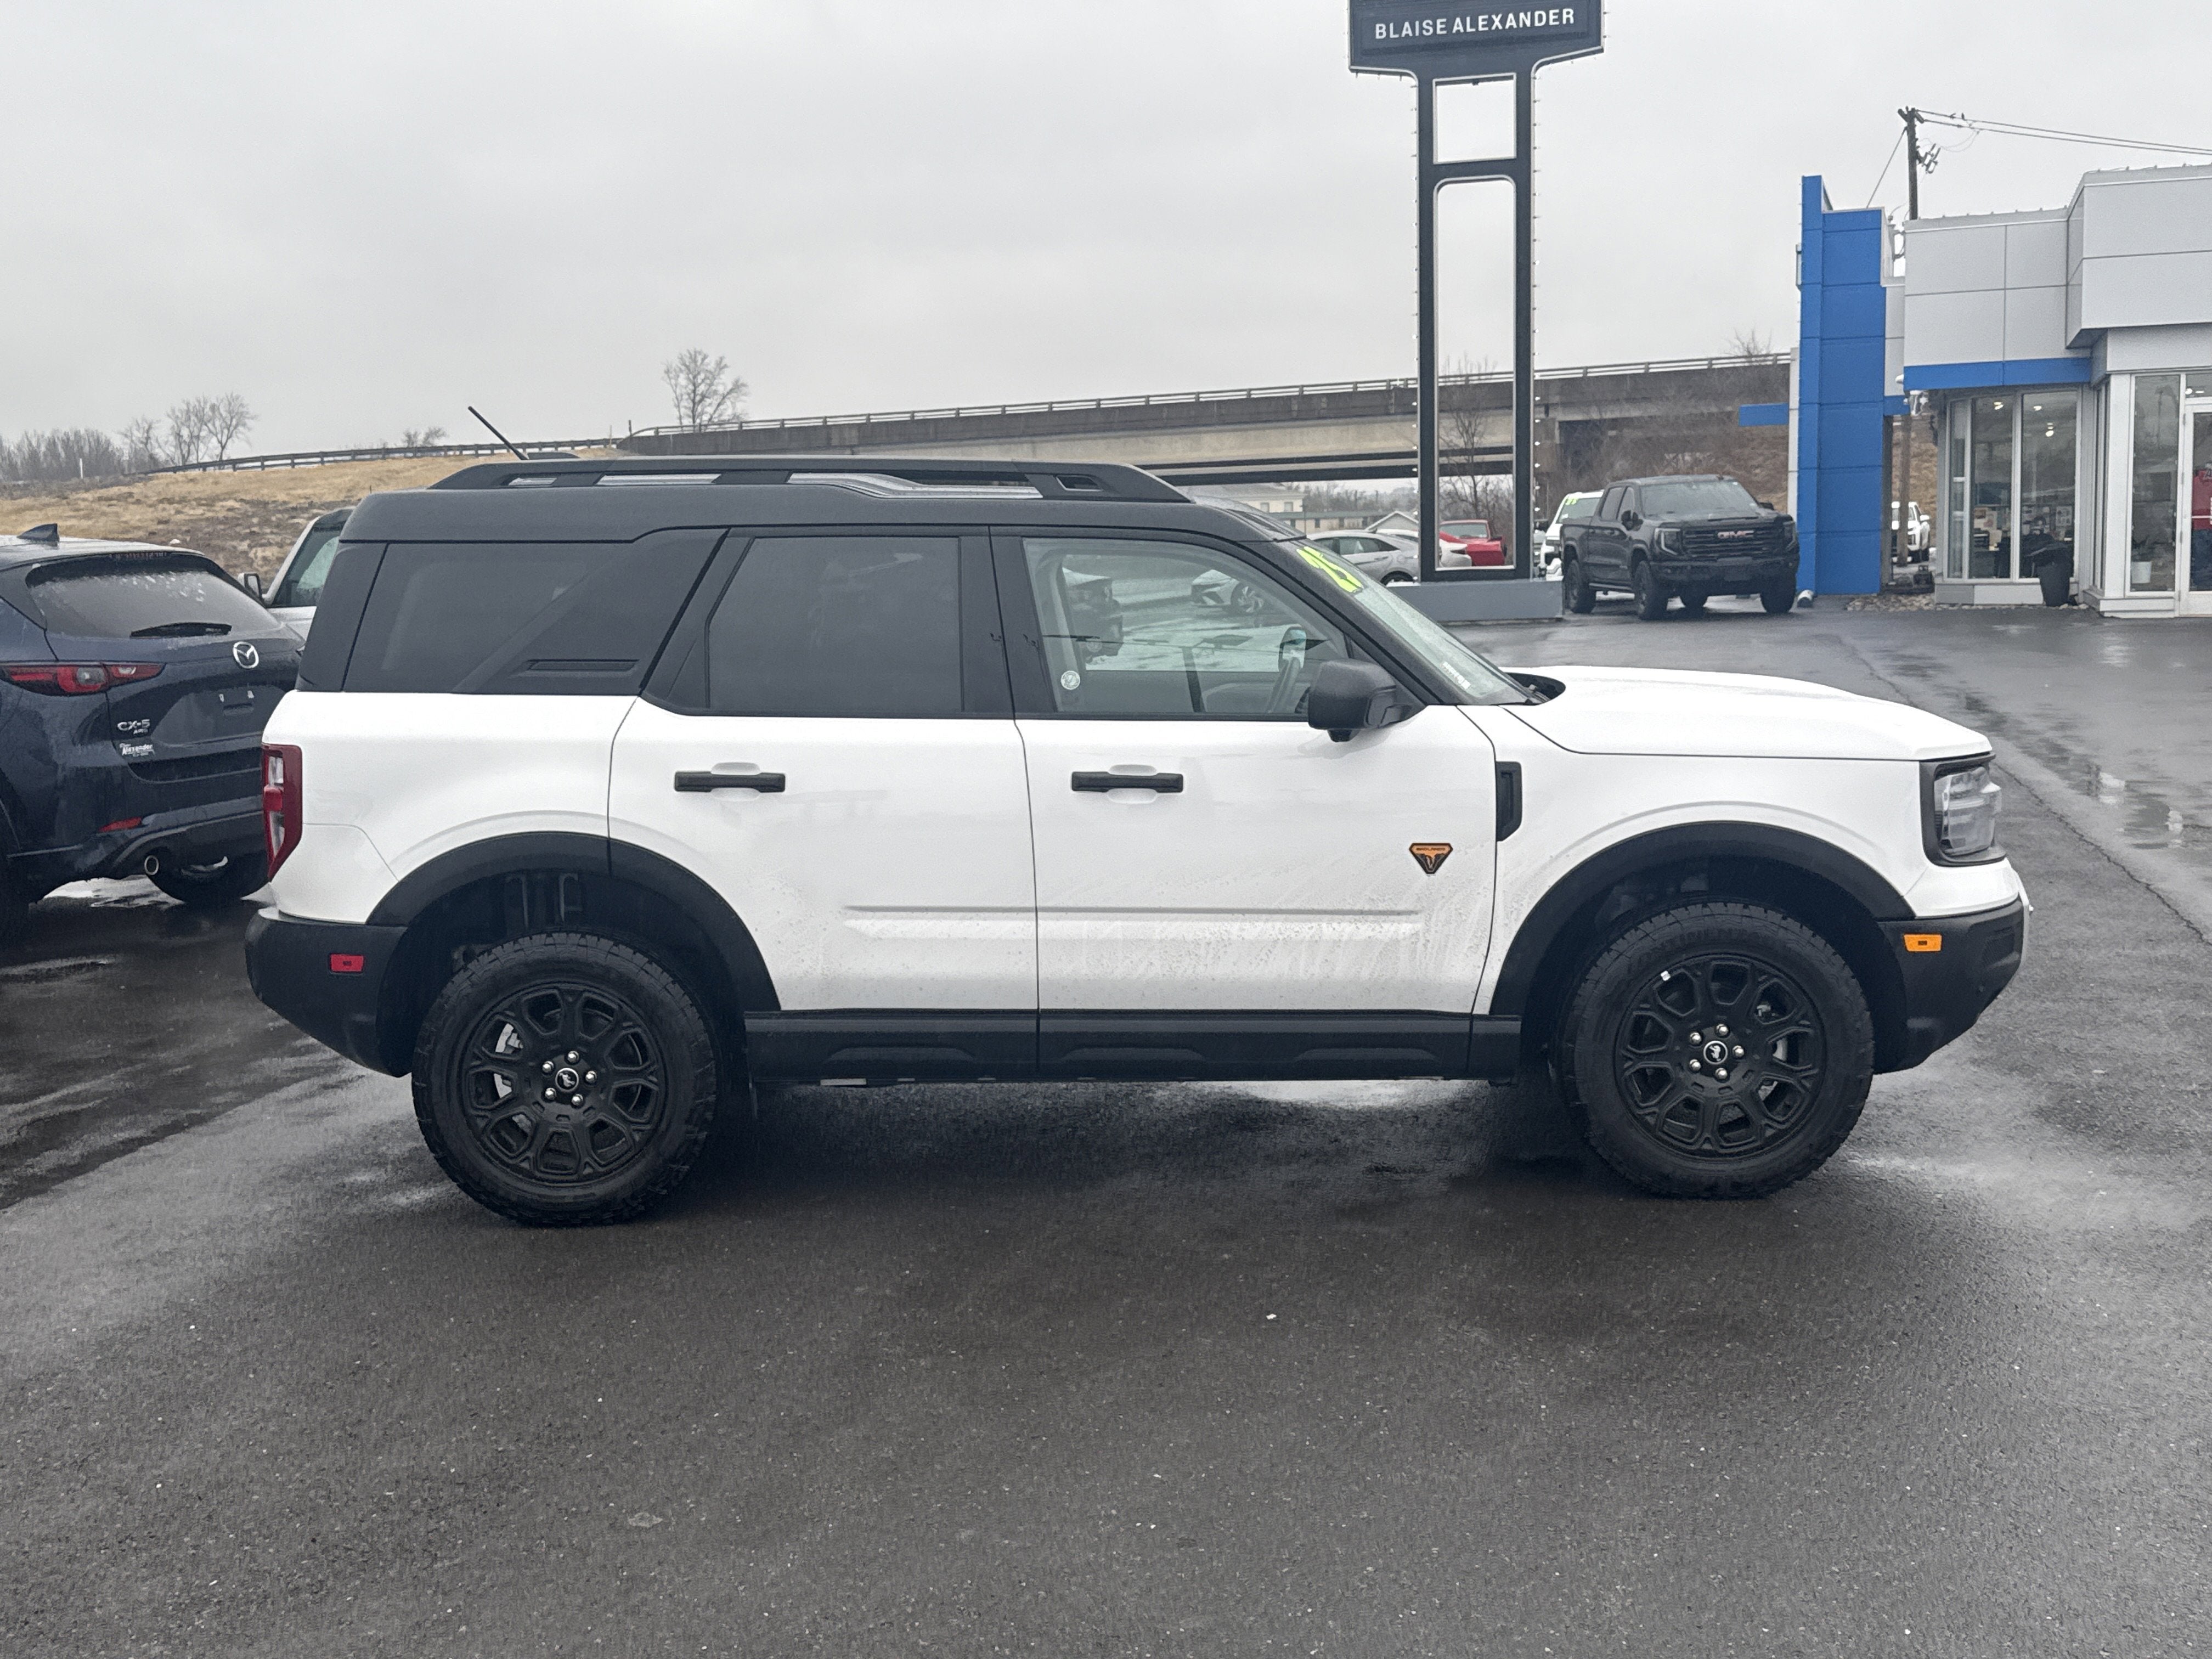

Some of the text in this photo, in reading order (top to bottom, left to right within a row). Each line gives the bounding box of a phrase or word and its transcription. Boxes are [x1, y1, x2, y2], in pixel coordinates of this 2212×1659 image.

[1375, 8, 1575, 40] BLAISE ALEXANDER
[1717, 530, 1754, 539] GMC
[117, 719, 150, 731] CX-5
